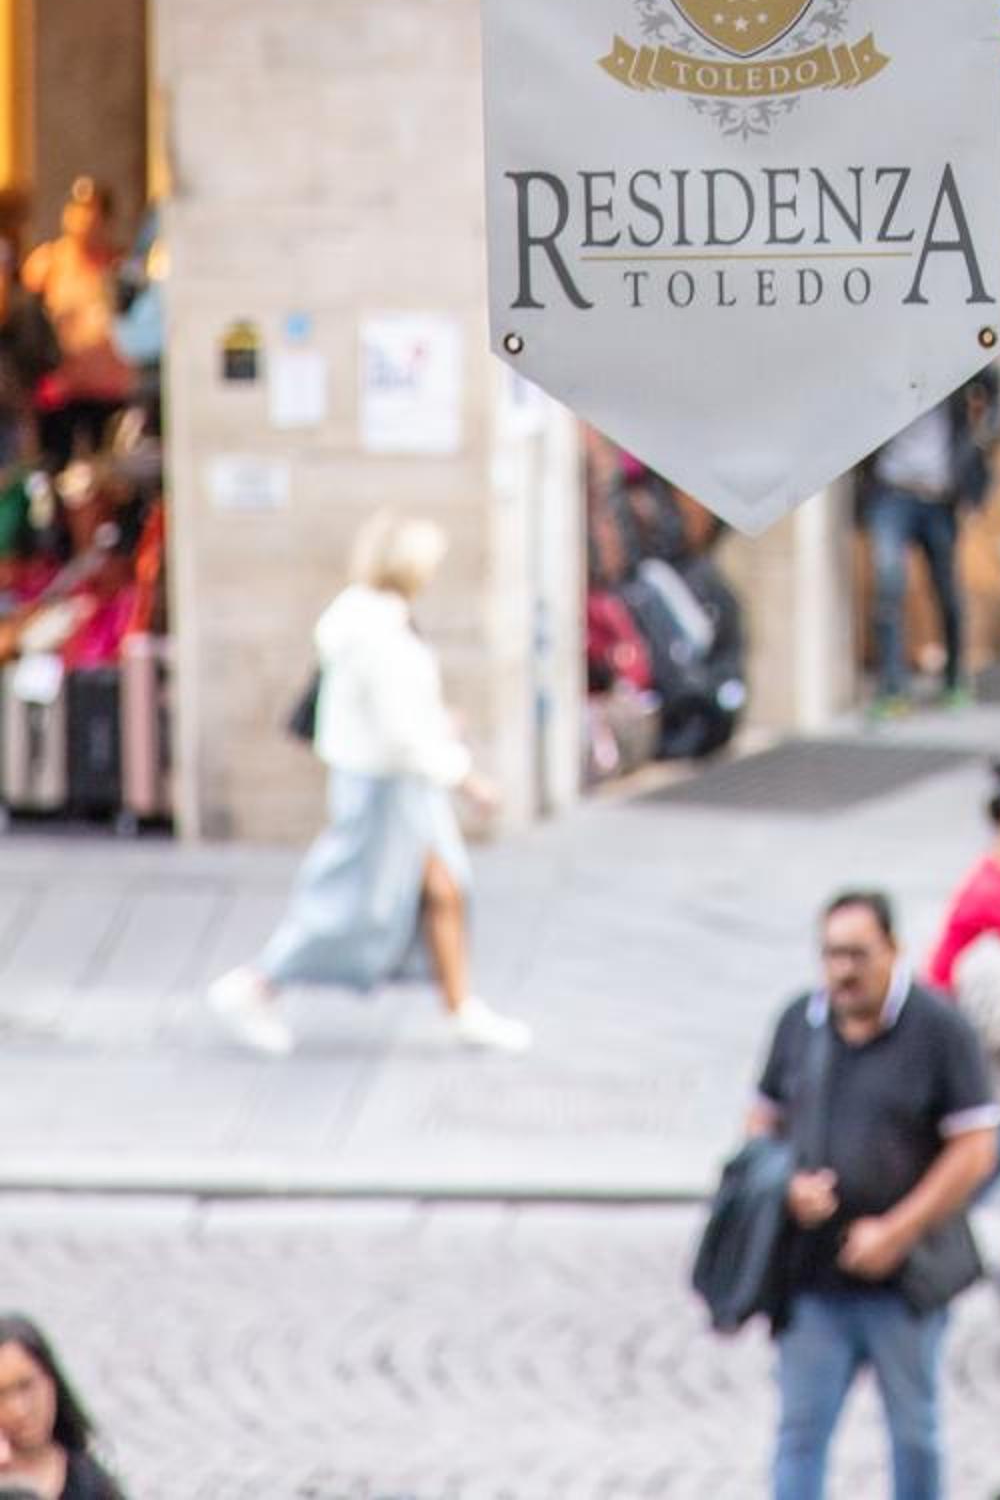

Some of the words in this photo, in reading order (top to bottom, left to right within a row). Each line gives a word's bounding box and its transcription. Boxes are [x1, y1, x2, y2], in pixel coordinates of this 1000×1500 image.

[672, 60, 818, 91] TOLEDO
[505, 162, 996, 309] RESIDENZA
[623, 268, 872, 307] TOLEDO
